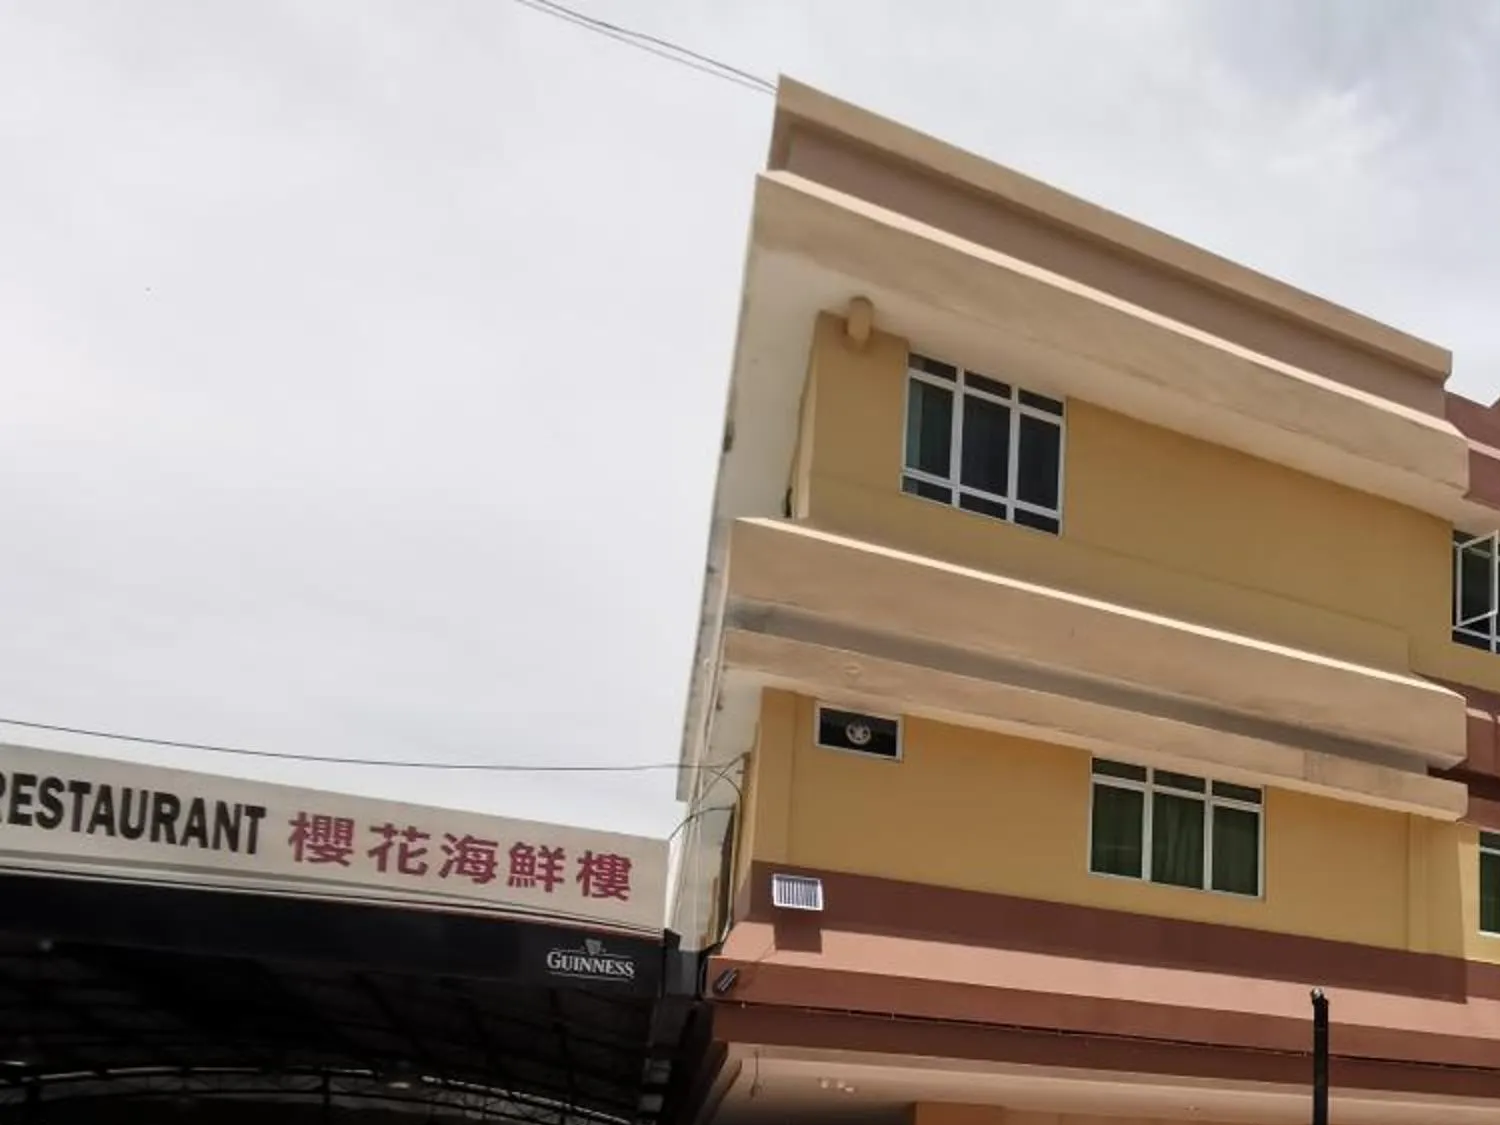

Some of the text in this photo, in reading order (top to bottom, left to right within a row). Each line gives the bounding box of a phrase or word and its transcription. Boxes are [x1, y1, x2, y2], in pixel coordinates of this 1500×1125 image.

[0, 771, 266, 854] ESTAURANT
[288, 811, 632, 901] 櫻花海鮮樓
[546, 951, 635, 979] GUINNESS
